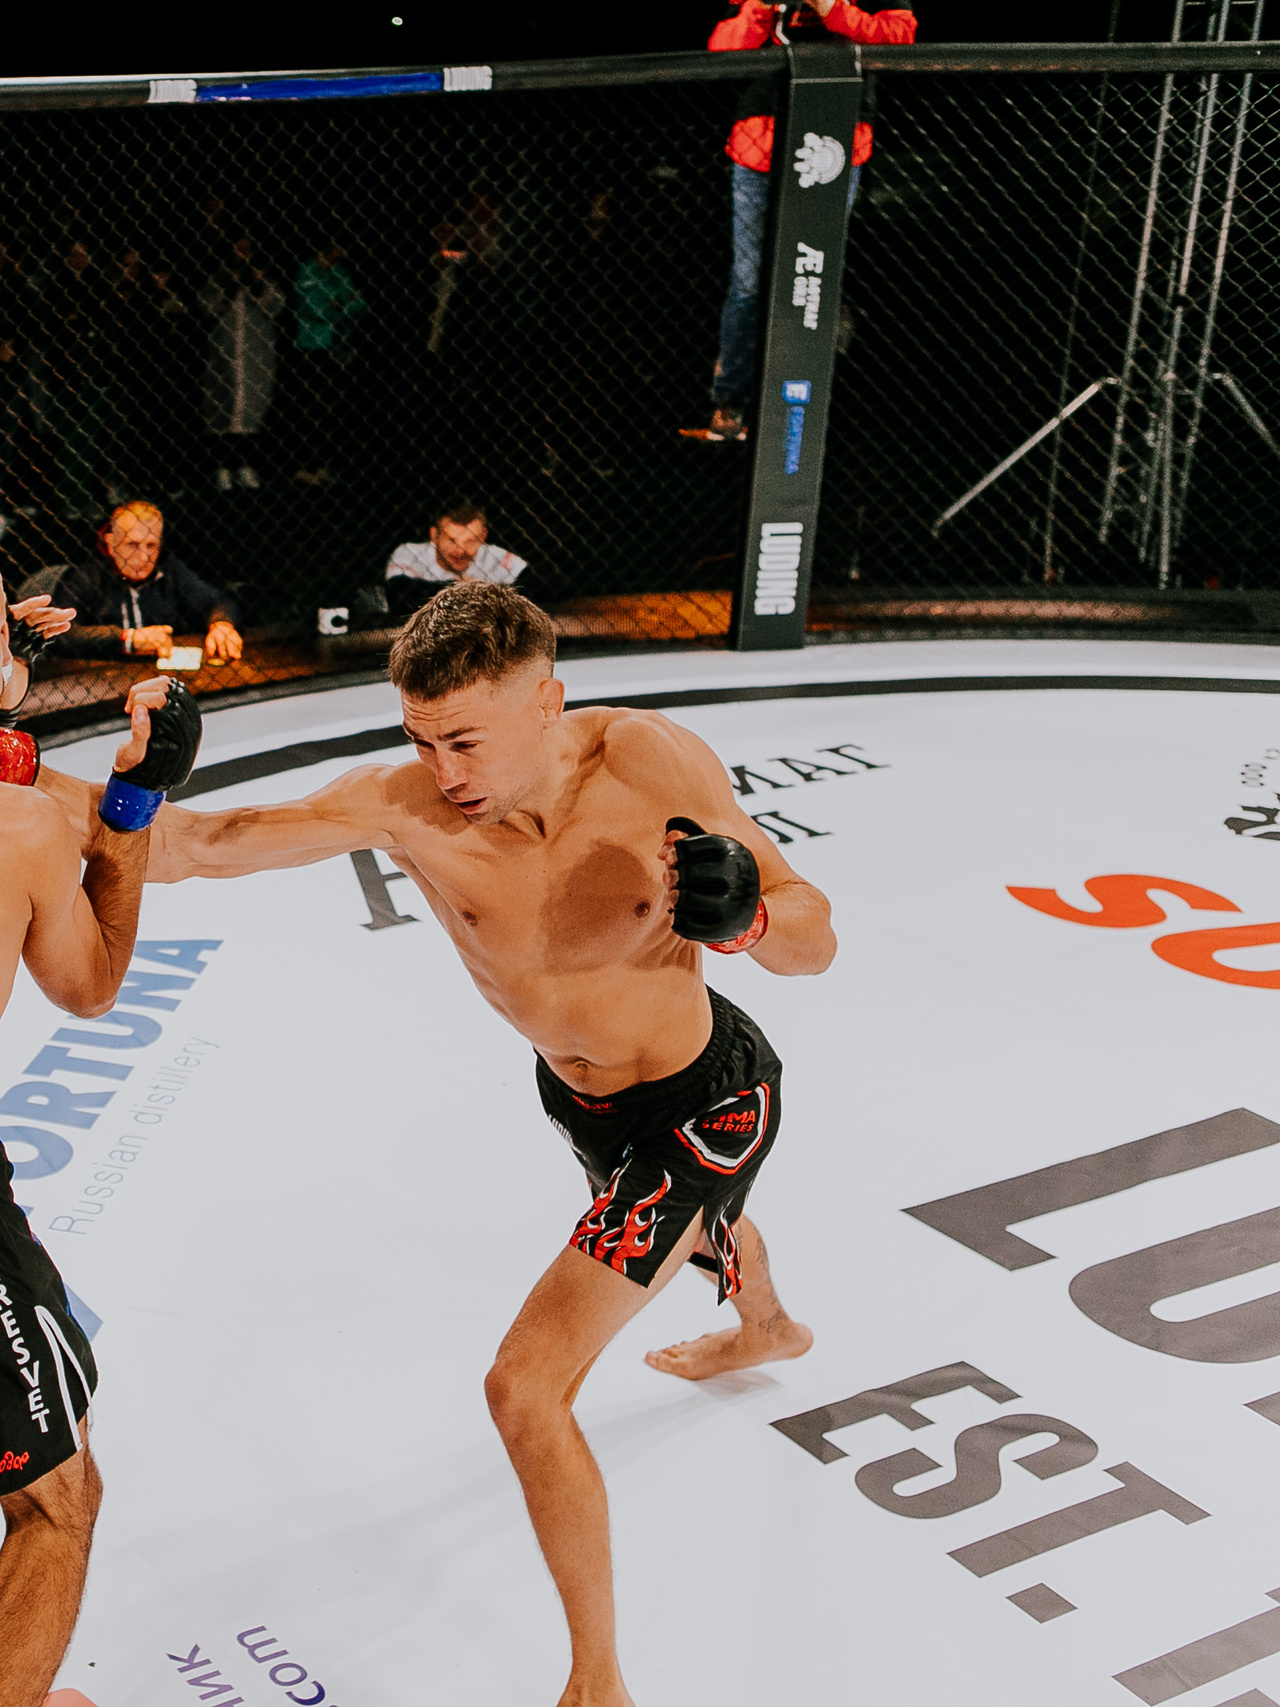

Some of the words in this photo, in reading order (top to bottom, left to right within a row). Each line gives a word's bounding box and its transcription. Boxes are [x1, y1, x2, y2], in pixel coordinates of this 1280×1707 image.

[754, 521, 804, 616] LUDING
[47, 1133, 150, 1235] Russian
[128, 1036, 221, 1126] distillery
[768, 1361, 1213, 1625] EST.
